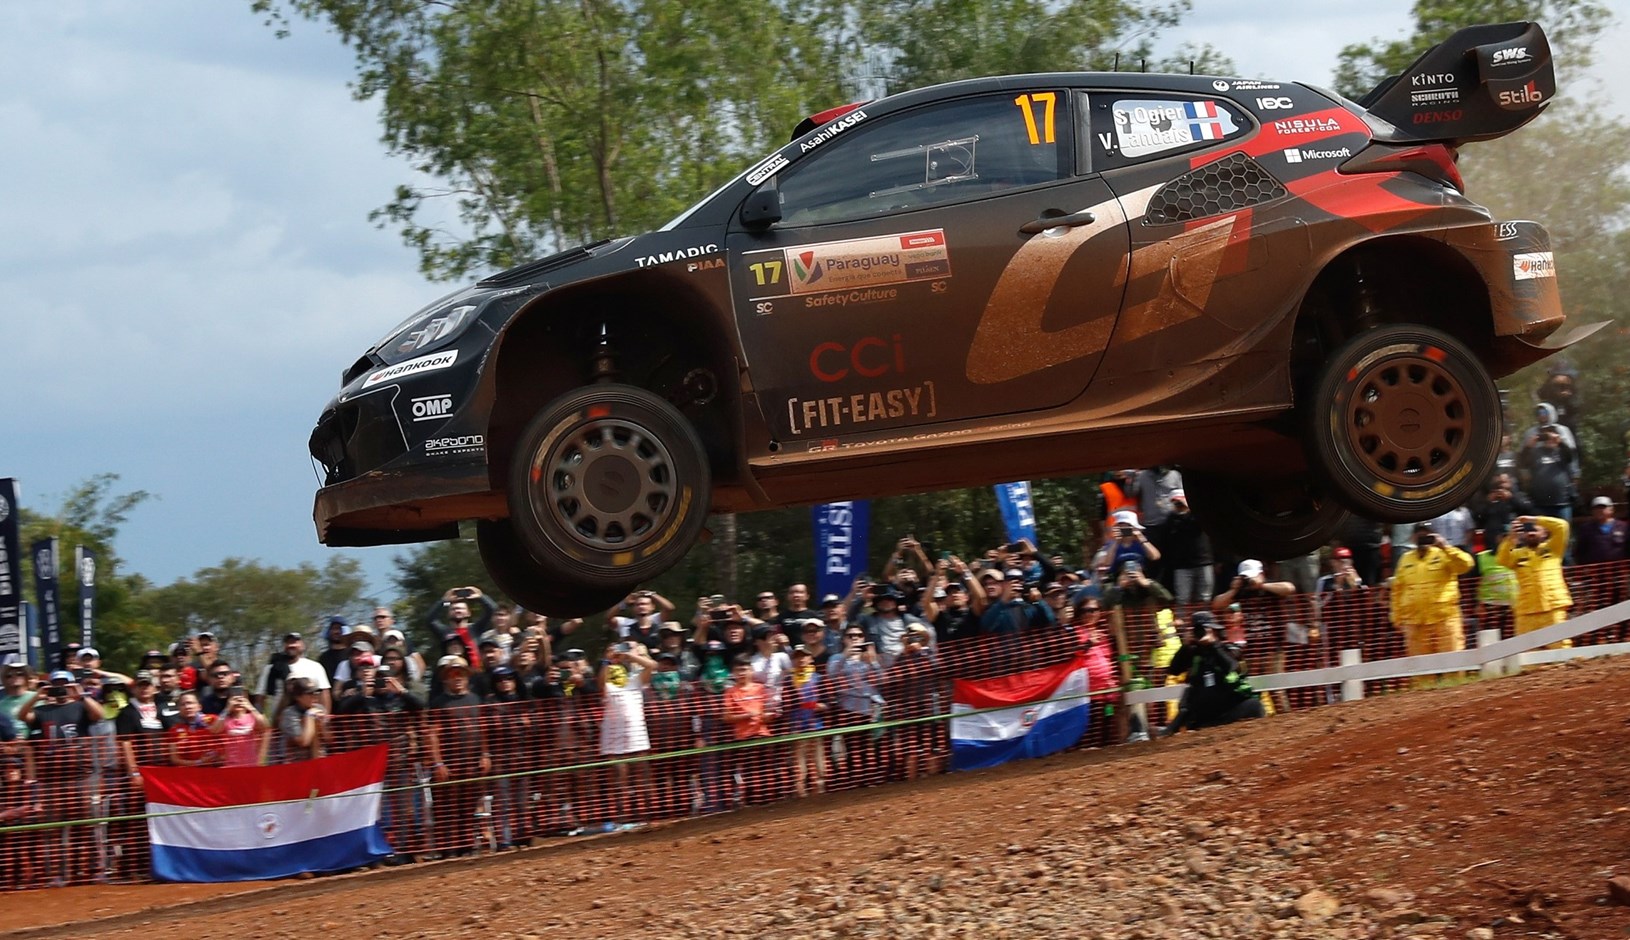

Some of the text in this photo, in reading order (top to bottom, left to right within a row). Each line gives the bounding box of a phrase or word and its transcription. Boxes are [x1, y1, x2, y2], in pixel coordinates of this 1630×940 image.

[1493, 47, 1527, 63] SWS
[1499, 83, 1542, 105] Stilo
[1015, 91, 1057, 145] 17
[1274, 118, 1338, 130] NISULA
[1413, 109, 1463, 124] DENSO
[1301, 147, 1352, 160] Microsoft
[634, 244, 719, 268] TAMADIC
[826, 253, 900, 271] Paraguay
[687, 258, 726, 272] PIAA
[749, 260, 782, 286] 17
[931, 281, 948, 293] SC
[756, 302, 774, 314] SC
[411, 398, 453, 417] OMP
